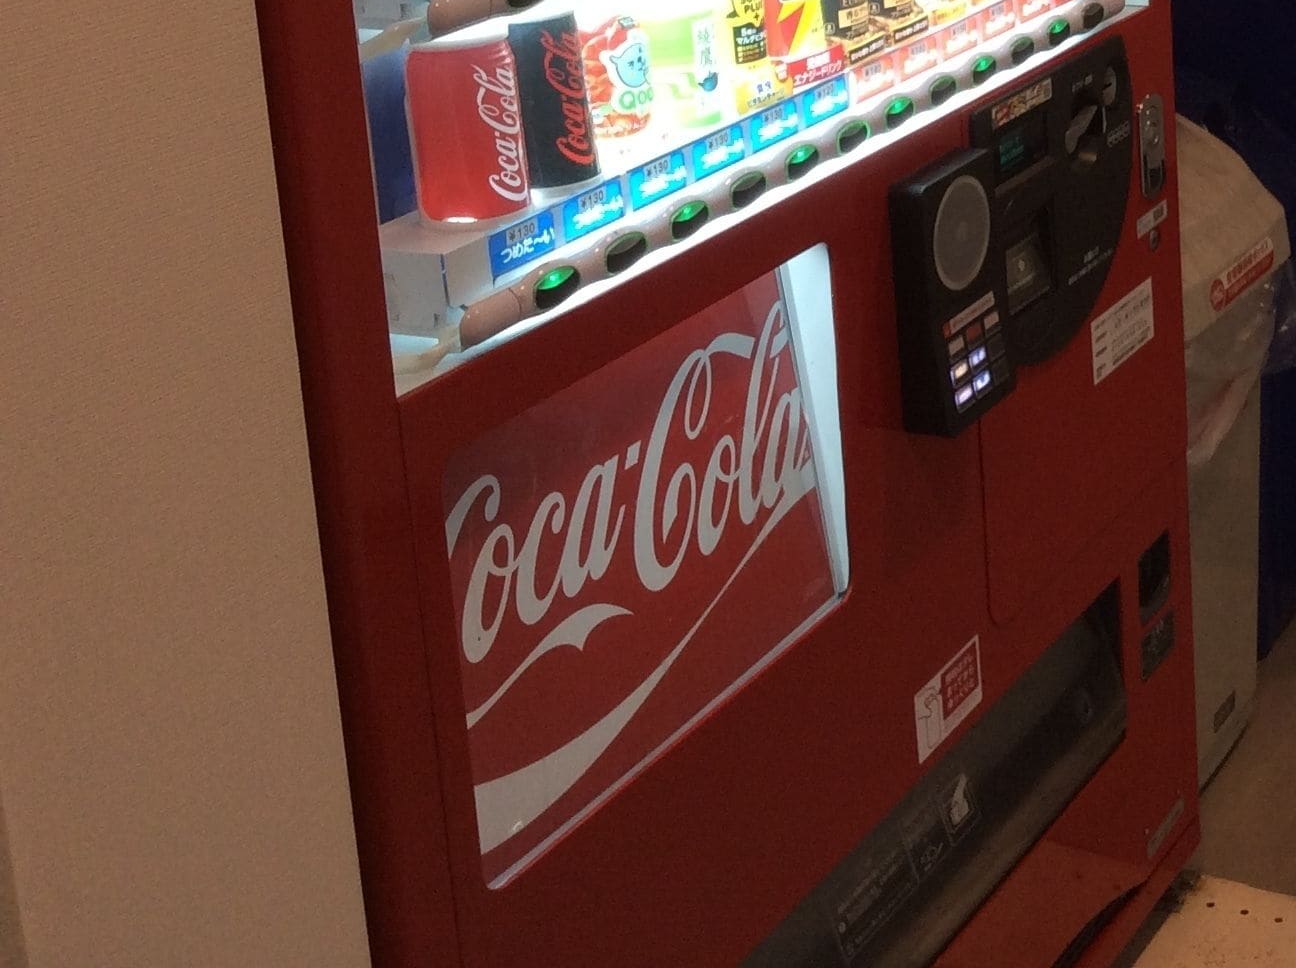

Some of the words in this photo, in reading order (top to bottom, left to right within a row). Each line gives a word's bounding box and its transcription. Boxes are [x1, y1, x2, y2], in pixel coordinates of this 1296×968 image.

[707, 132, 729, 151] ¥130
[645, 158, 670, 178] ¥130
[580, 190, 605, 210] ¥130
[508, 222, 537, 243] ¥130
